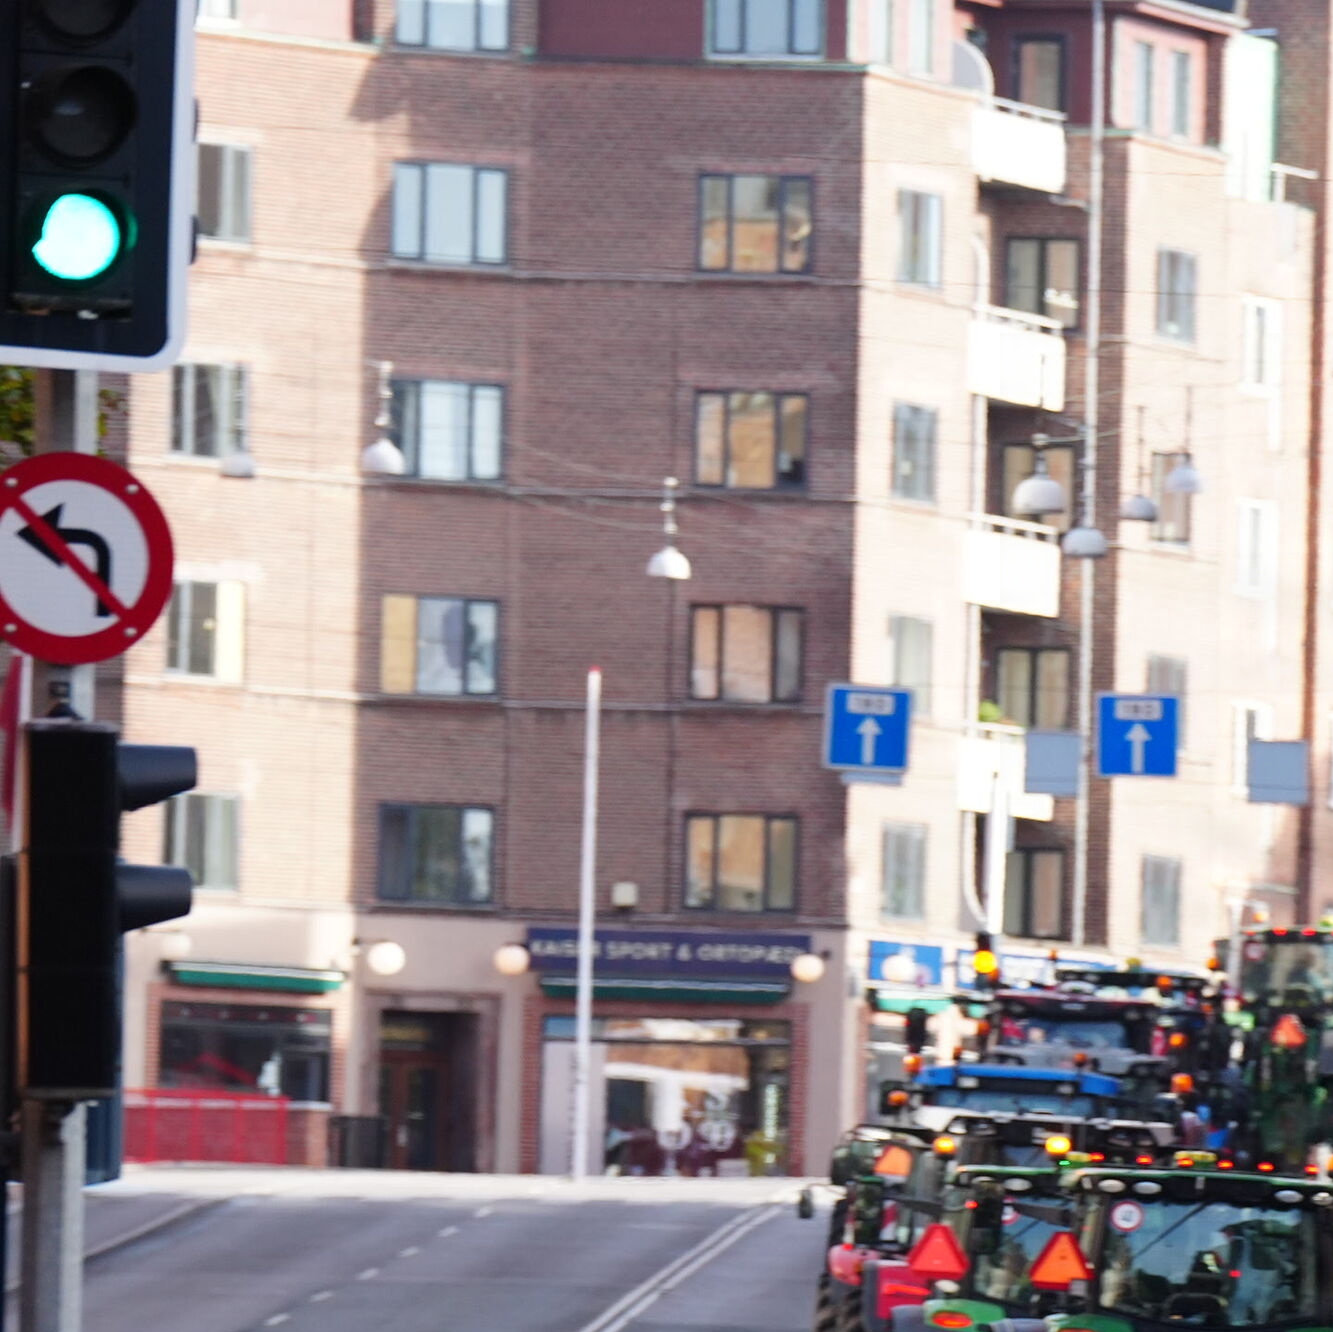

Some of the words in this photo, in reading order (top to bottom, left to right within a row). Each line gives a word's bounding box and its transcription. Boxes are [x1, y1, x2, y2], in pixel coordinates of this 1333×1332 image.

[531, 939, 601, 958] KAISR
[606, 940, 672, 960] SPORT
[676, 942, 691, 961] &
